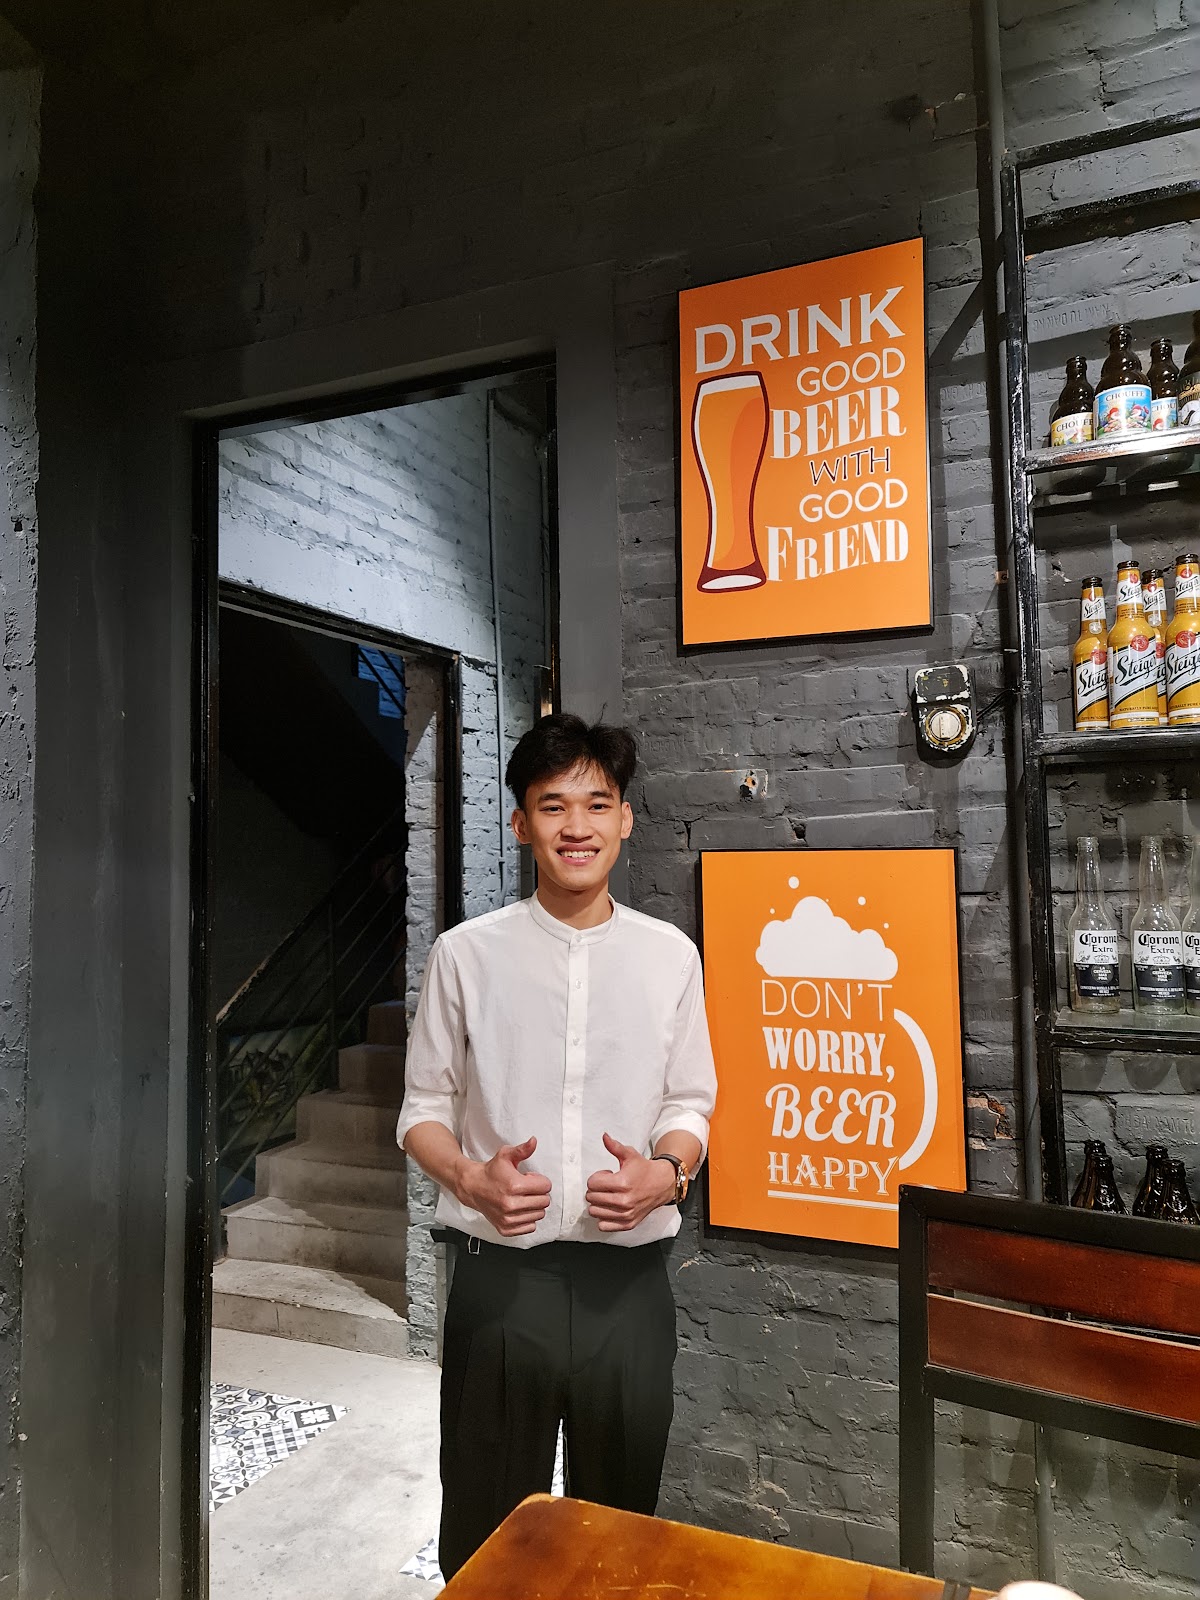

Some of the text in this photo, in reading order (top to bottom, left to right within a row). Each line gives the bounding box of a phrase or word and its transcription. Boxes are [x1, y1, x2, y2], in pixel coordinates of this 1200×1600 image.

[694, 286, 906, 374] DRINK
[796, 347, 906, 397] GOOD
[1105, 390, 1145, 402] CHOUFFE
[769, 385, 908, 459] BEER
[808, 446, 892, 487] WITH
[798, 477, 910, 524] GOOD
[764, 517, 910, 583] FRIEND
[1092, 944, 1114, 953] Extra
[1138, 932, 1180, 948] Corona
[1150, 945, 1175, 954] Extra
[762, 979, 893, 1022] DON'T
[761, 1026, 896, 1083] WORRY,
[764, 1083, 897, 1149] BEER
[766, 1151, 900, 1196] HAPPY
